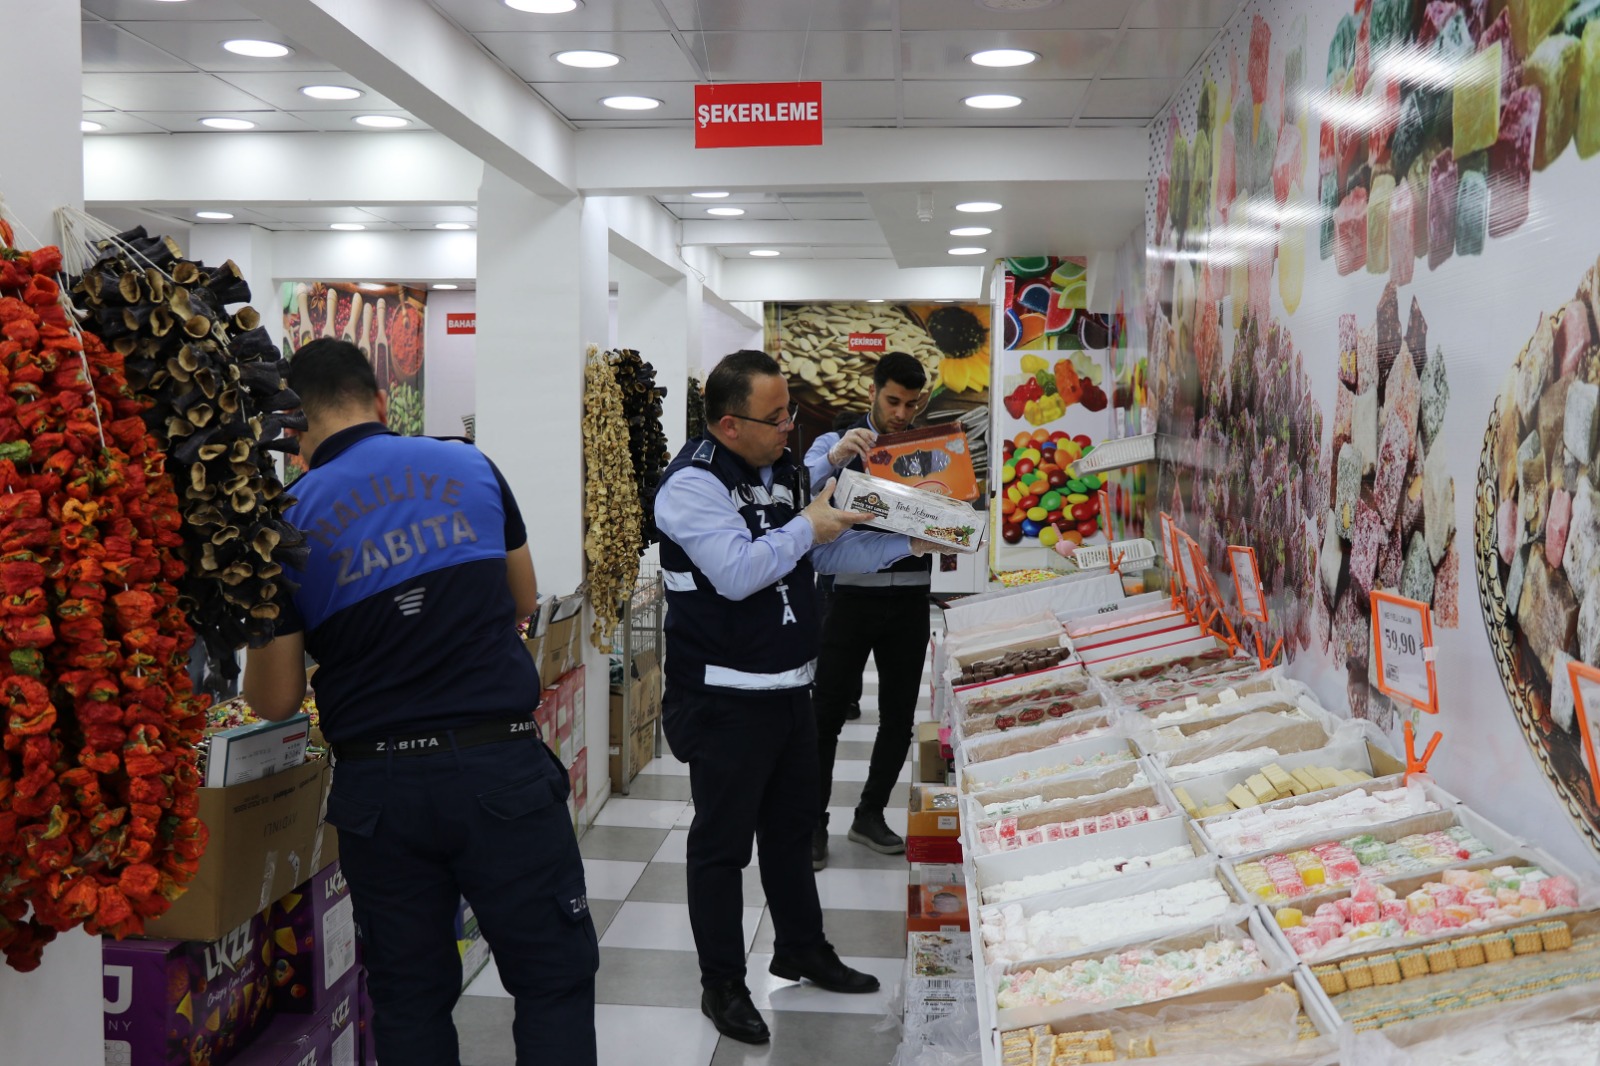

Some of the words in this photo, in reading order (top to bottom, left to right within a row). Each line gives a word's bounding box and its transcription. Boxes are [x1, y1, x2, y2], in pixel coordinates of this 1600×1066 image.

[698, 101, 818, 129] ŞEKERLEME
[308, 465, 464, 549] HALİLİYE
[329, 510, 478, 587] ZABITA
[1385, 627, 1416, 656] 59,90
[204, 918, 254, 982] LKZZ
